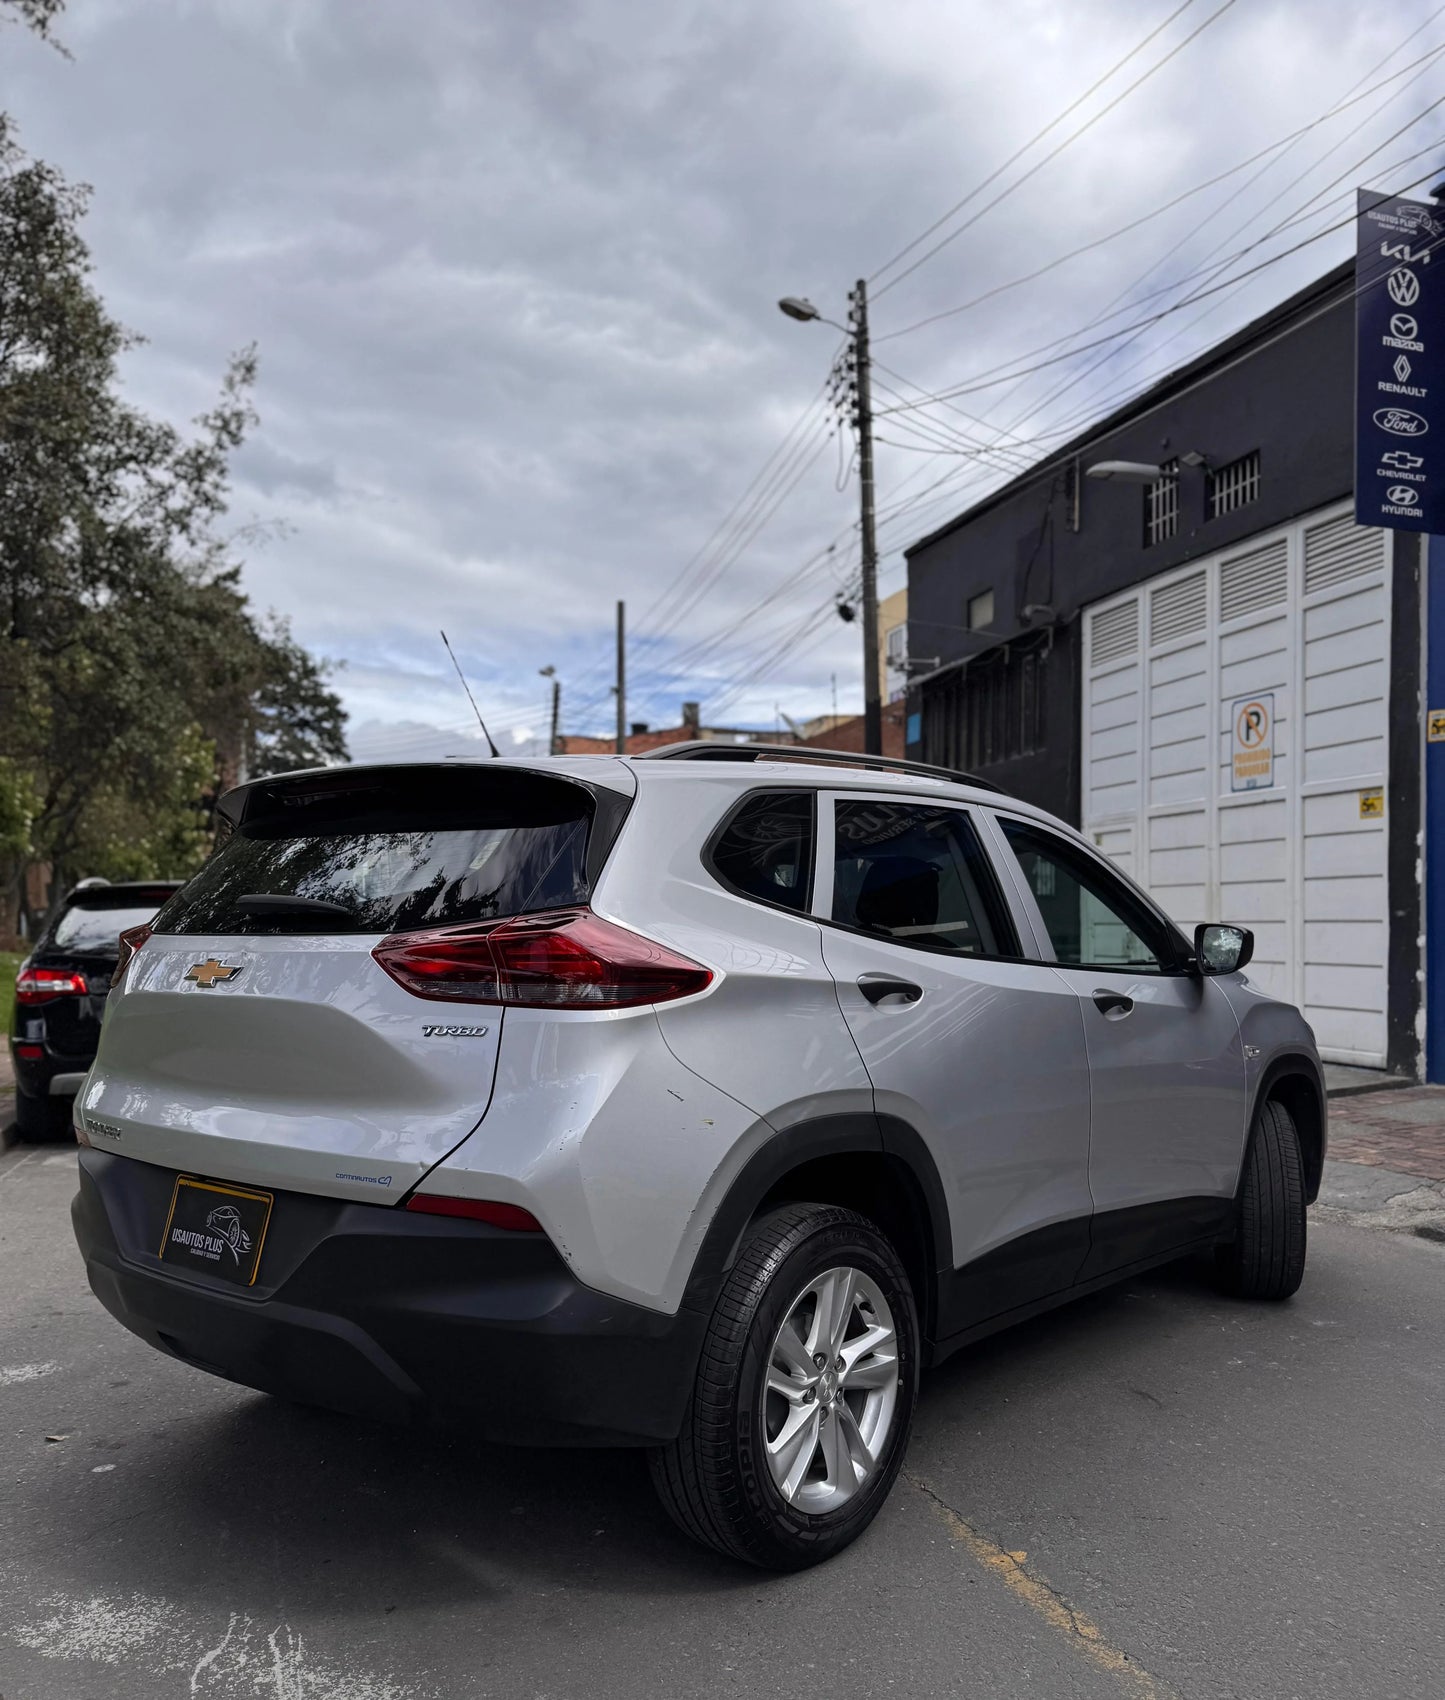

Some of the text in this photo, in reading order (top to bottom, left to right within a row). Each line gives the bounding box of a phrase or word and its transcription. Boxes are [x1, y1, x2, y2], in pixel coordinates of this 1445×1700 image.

[1378, 381, 1427, 397] RENAULT
[1384, 410, 1418, 433] Ford
[1377, 468, 1426, 482] CHEVROLET
[1382, 504, 1423, 517] HYUNDAI
[422, 1025, 488, 1037] TURBO
[171, 1228, 224, 1253] USAUTOS PLUS
